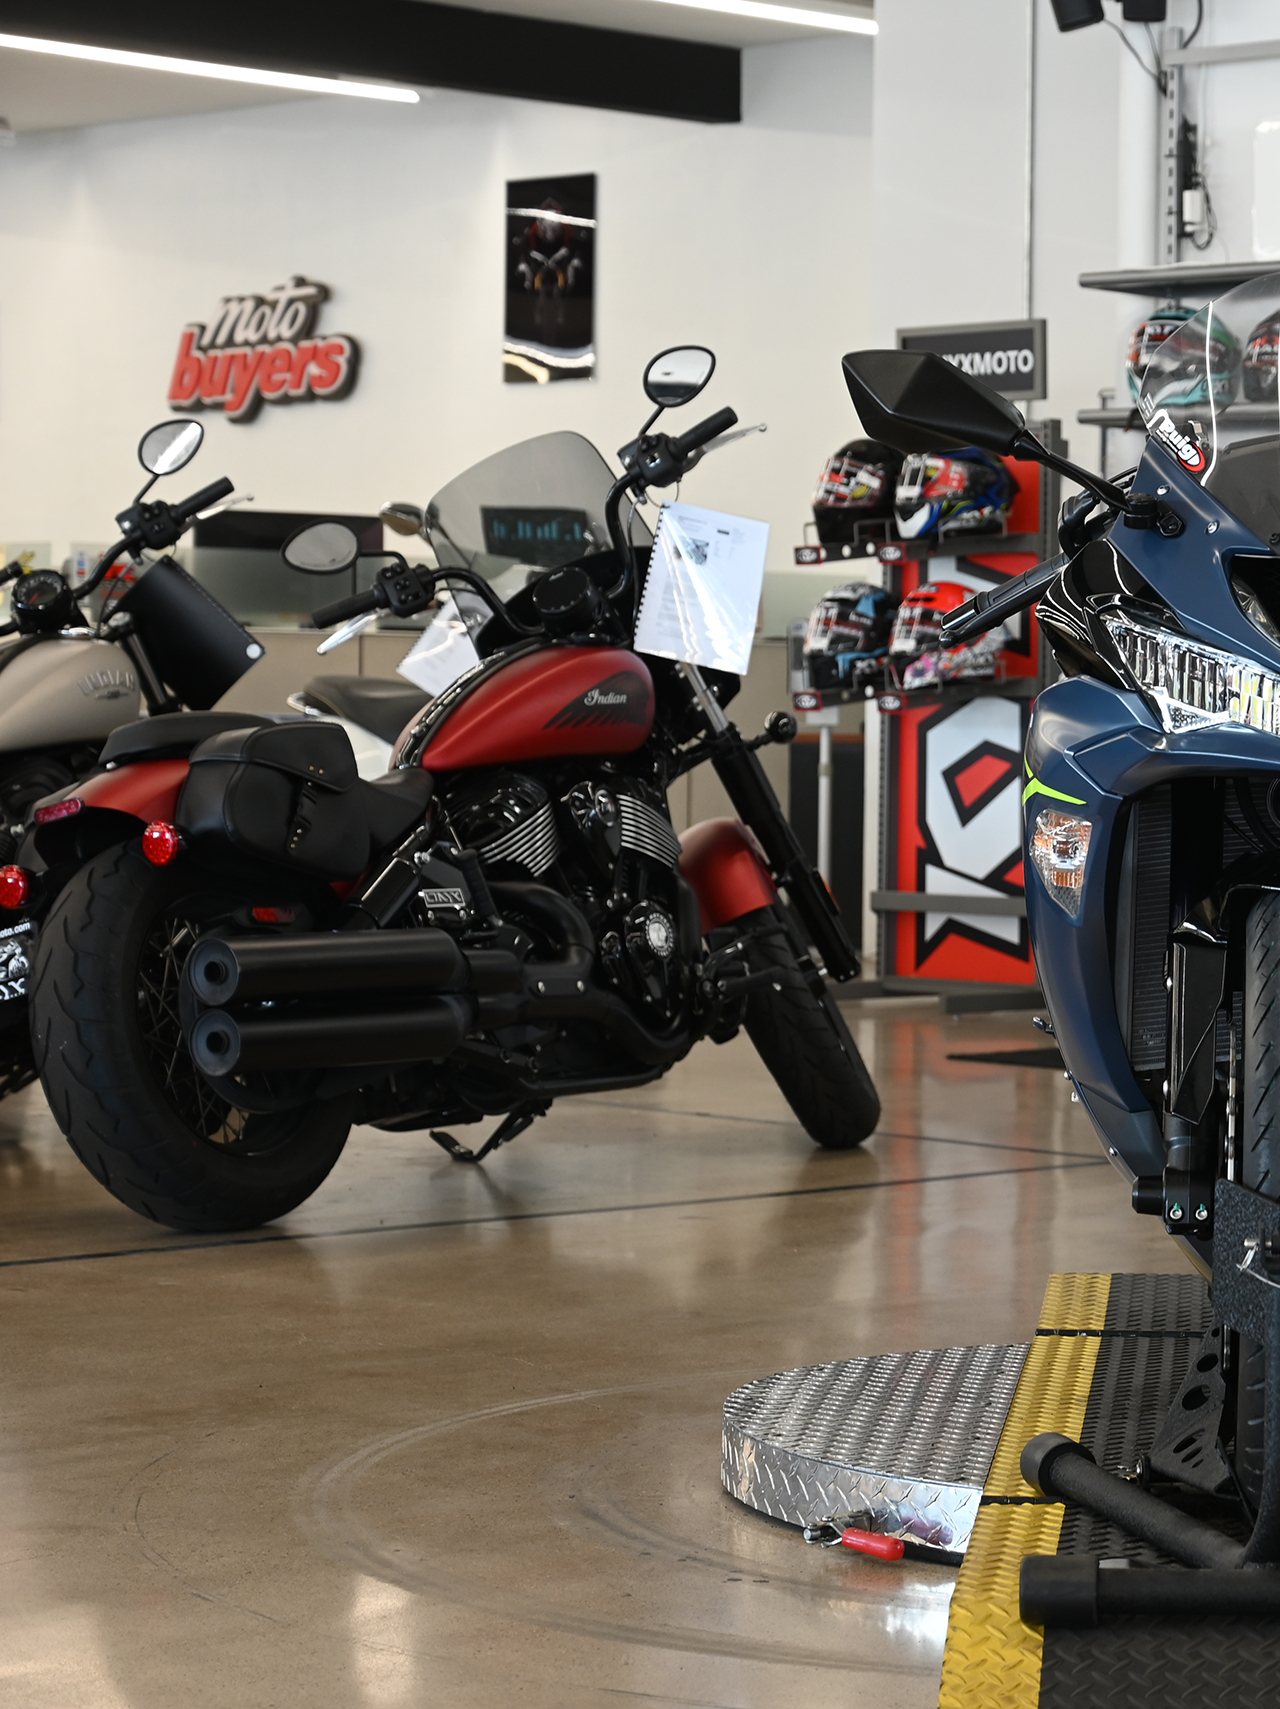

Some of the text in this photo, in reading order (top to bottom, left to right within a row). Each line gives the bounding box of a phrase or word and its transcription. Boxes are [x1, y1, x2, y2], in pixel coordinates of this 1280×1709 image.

[168, 326, 350, 415] buyers
[942, 349, 1035, 376] YXMOTO
[1152, 412, 1200, 467] Puig
[584, 689, 627, 706] Indian
